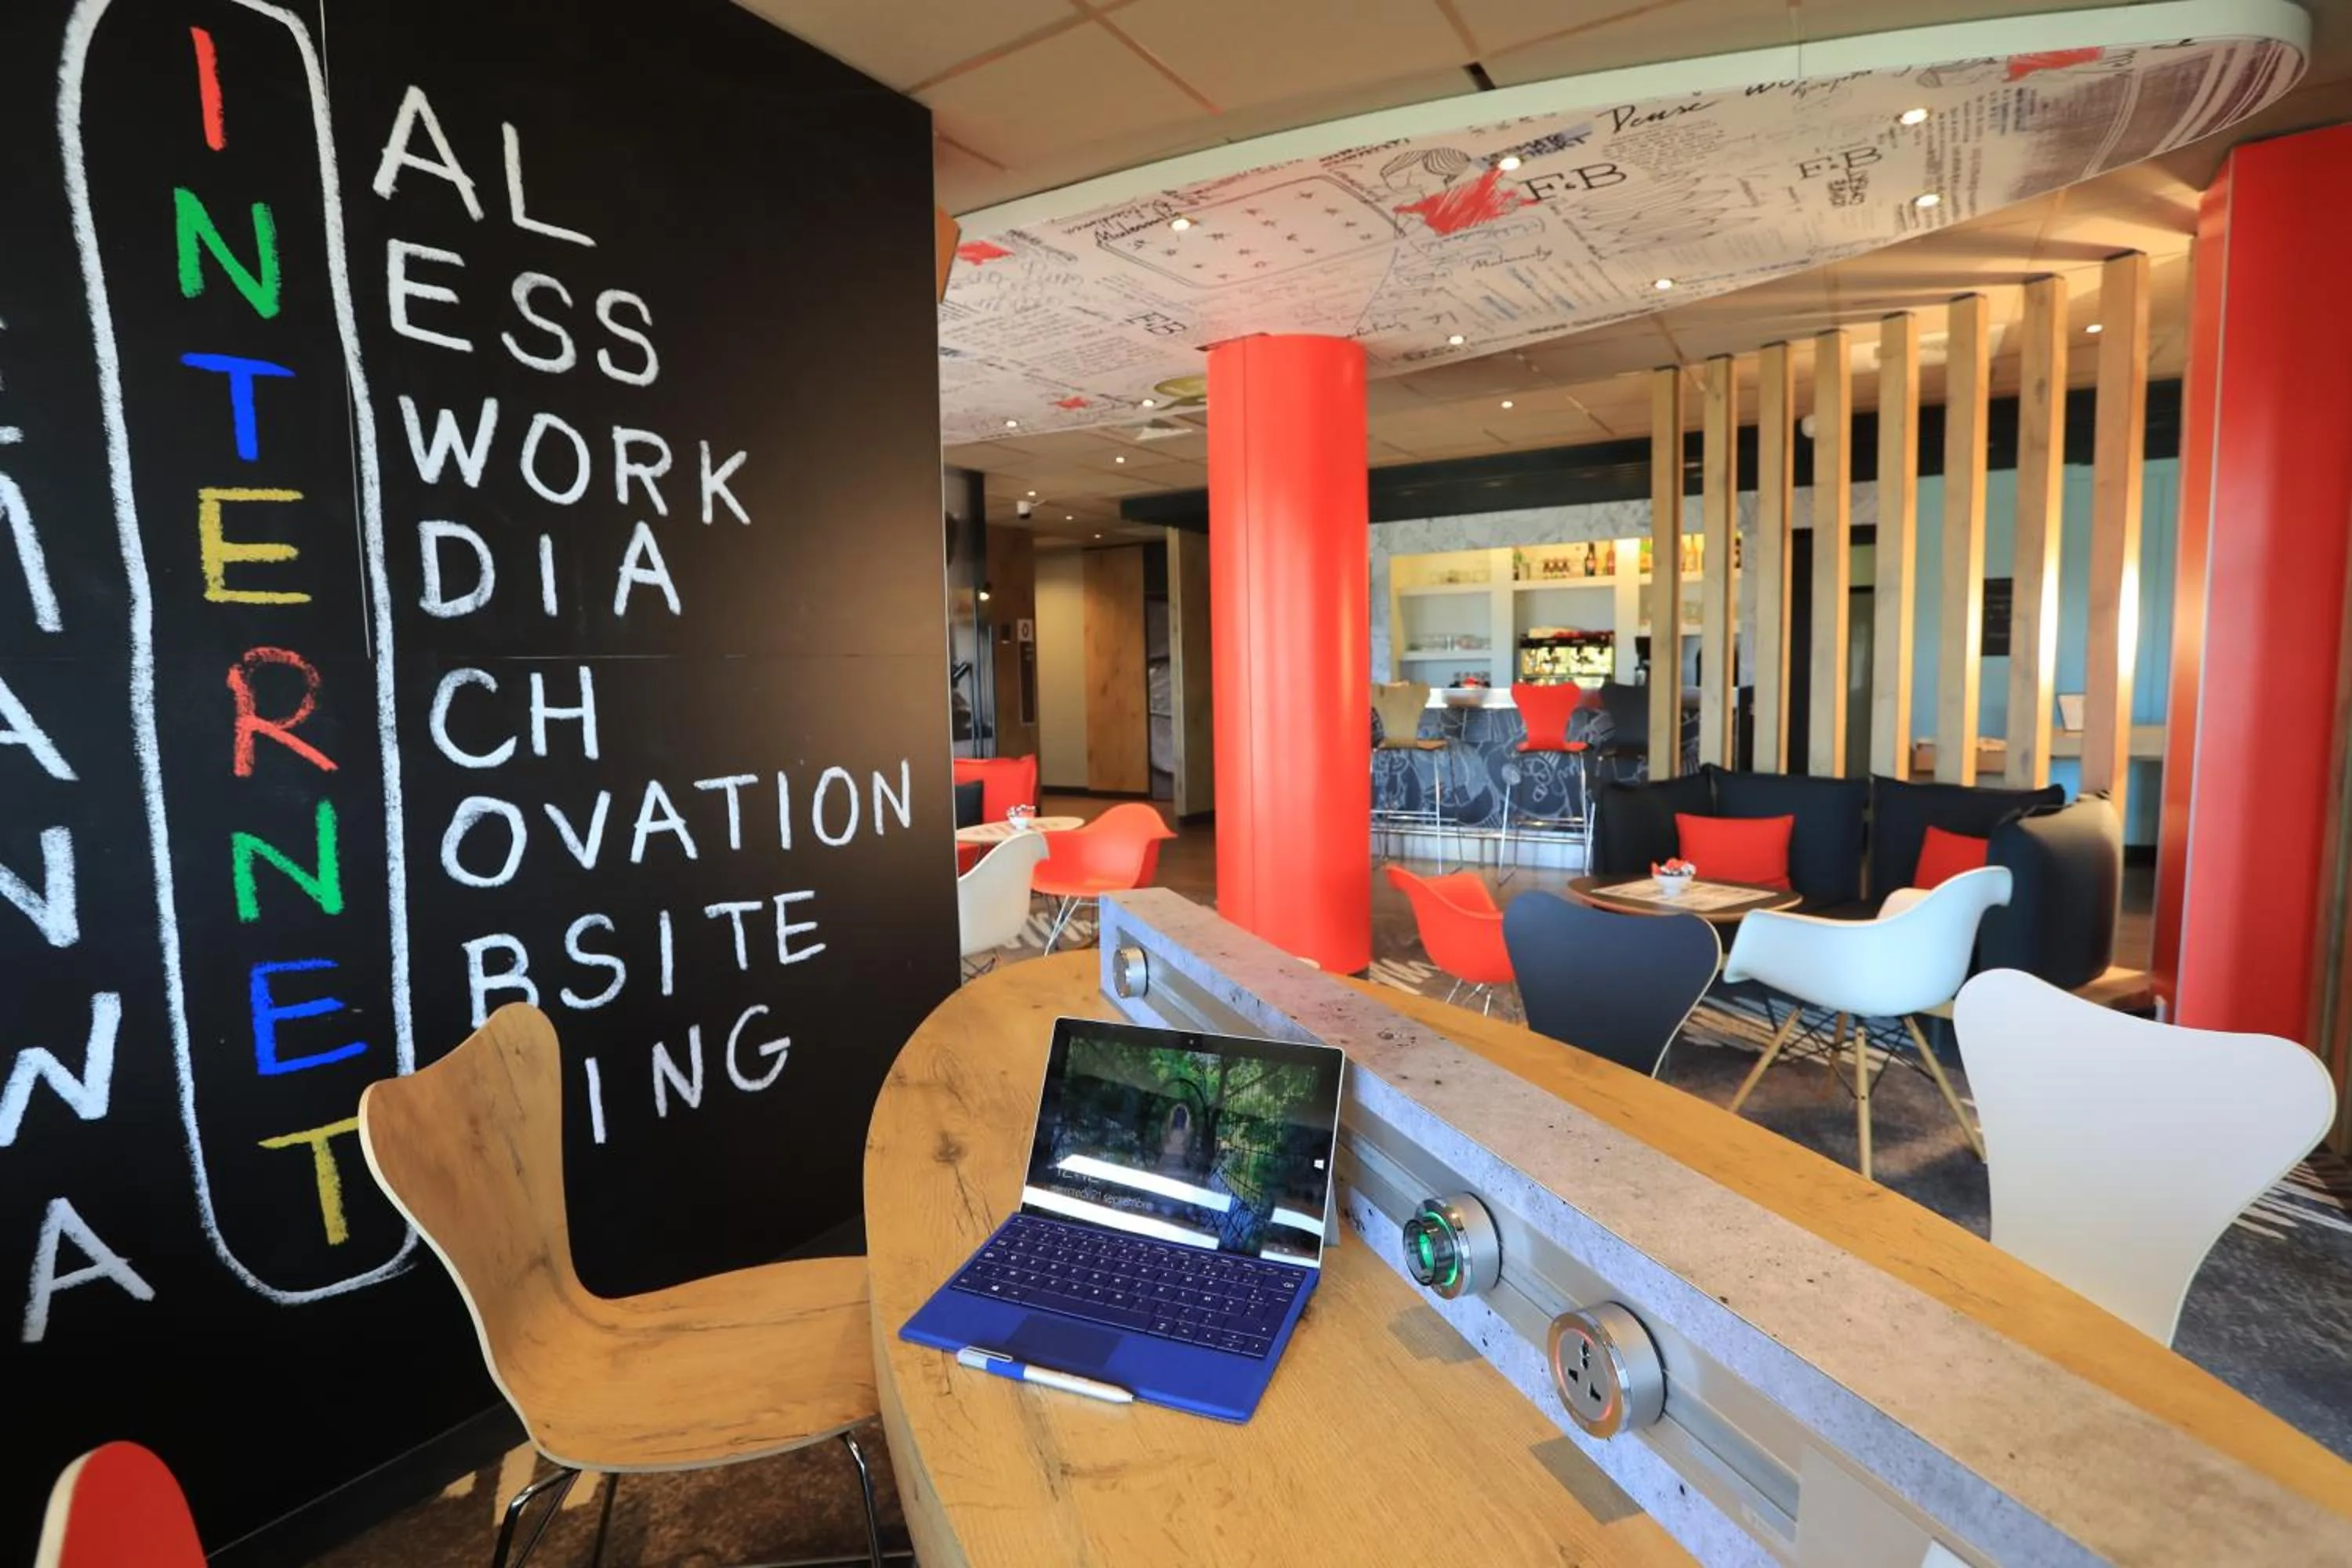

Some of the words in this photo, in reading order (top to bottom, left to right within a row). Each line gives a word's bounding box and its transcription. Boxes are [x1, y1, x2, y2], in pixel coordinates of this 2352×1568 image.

[387, 238, 659, 386] ESS
[399, 396, 750, 524] WORK
[419, 521, 681, 618] DIA
[430, 666, 599, 768] CH
[441, 759, 911, 887] OVATION
